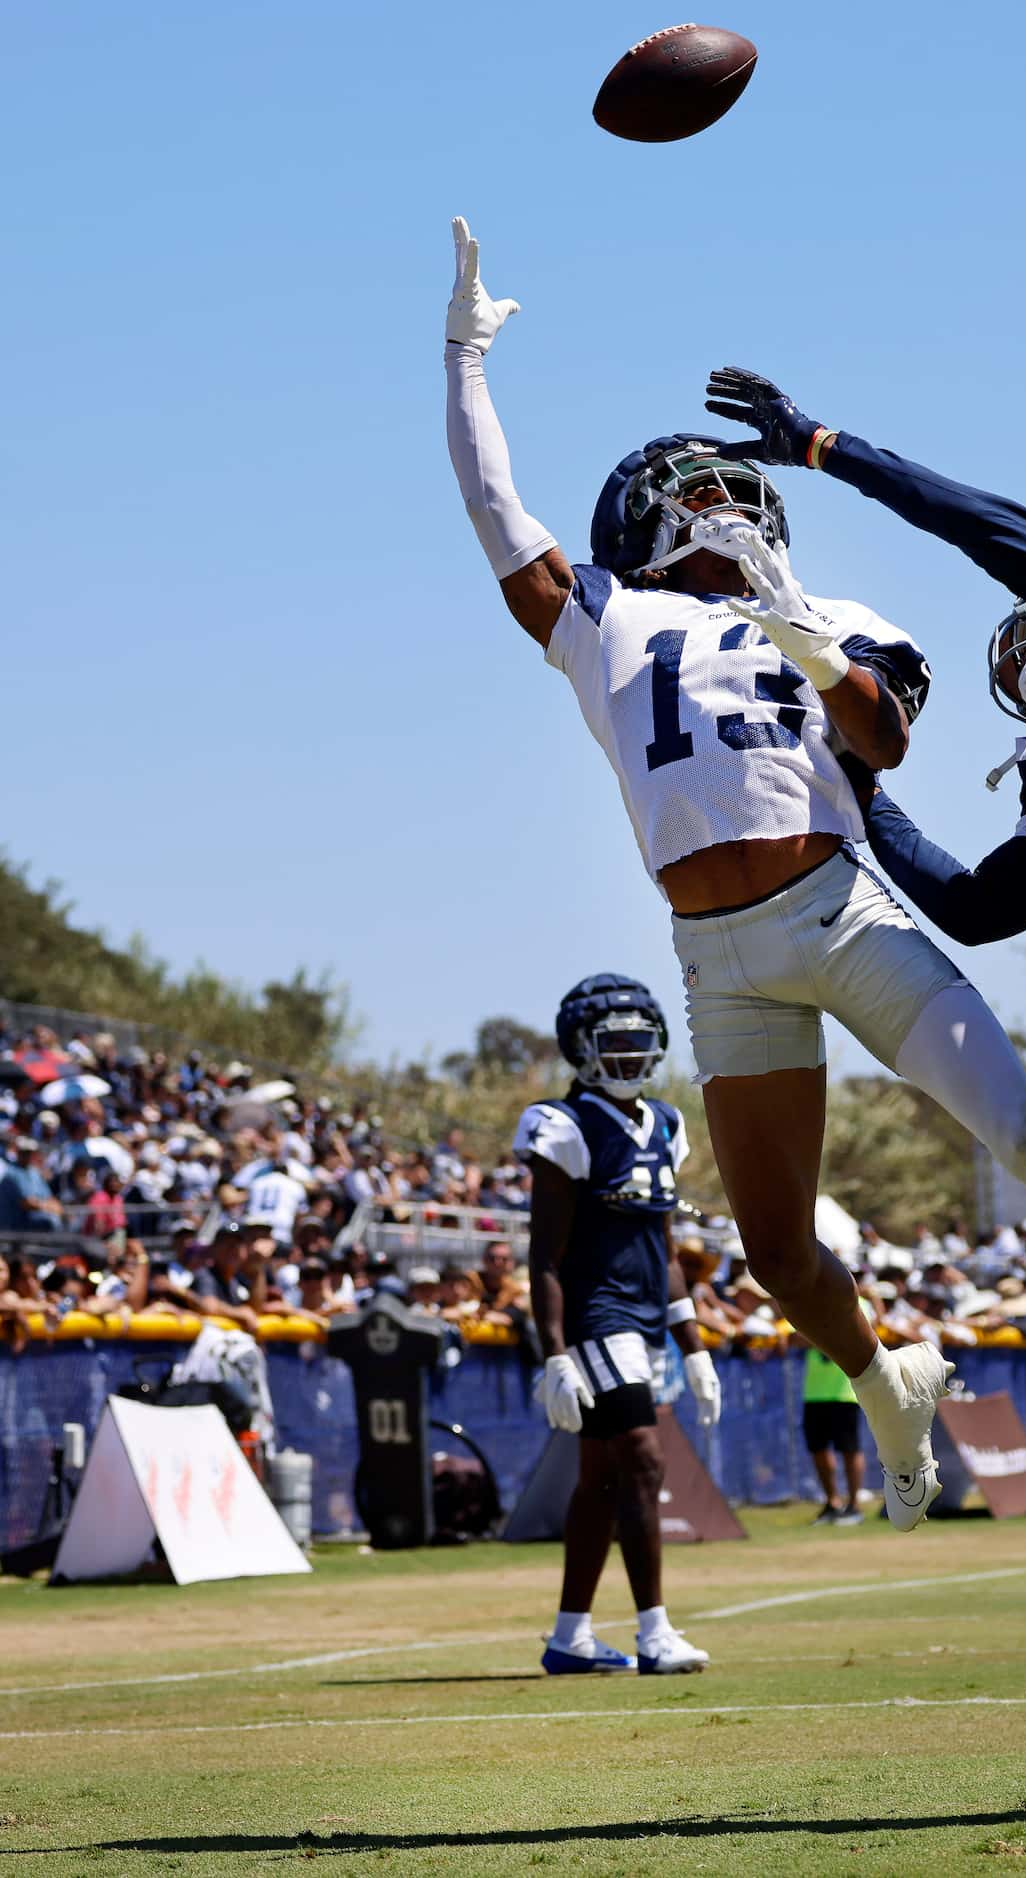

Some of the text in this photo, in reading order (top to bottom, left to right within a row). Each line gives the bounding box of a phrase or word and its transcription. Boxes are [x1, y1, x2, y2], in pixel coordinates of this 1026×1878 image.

[811, 609, 836, 626] T&T
[644, 622, 808, 773] 13
[369, 1399, 412, 1444] 01
